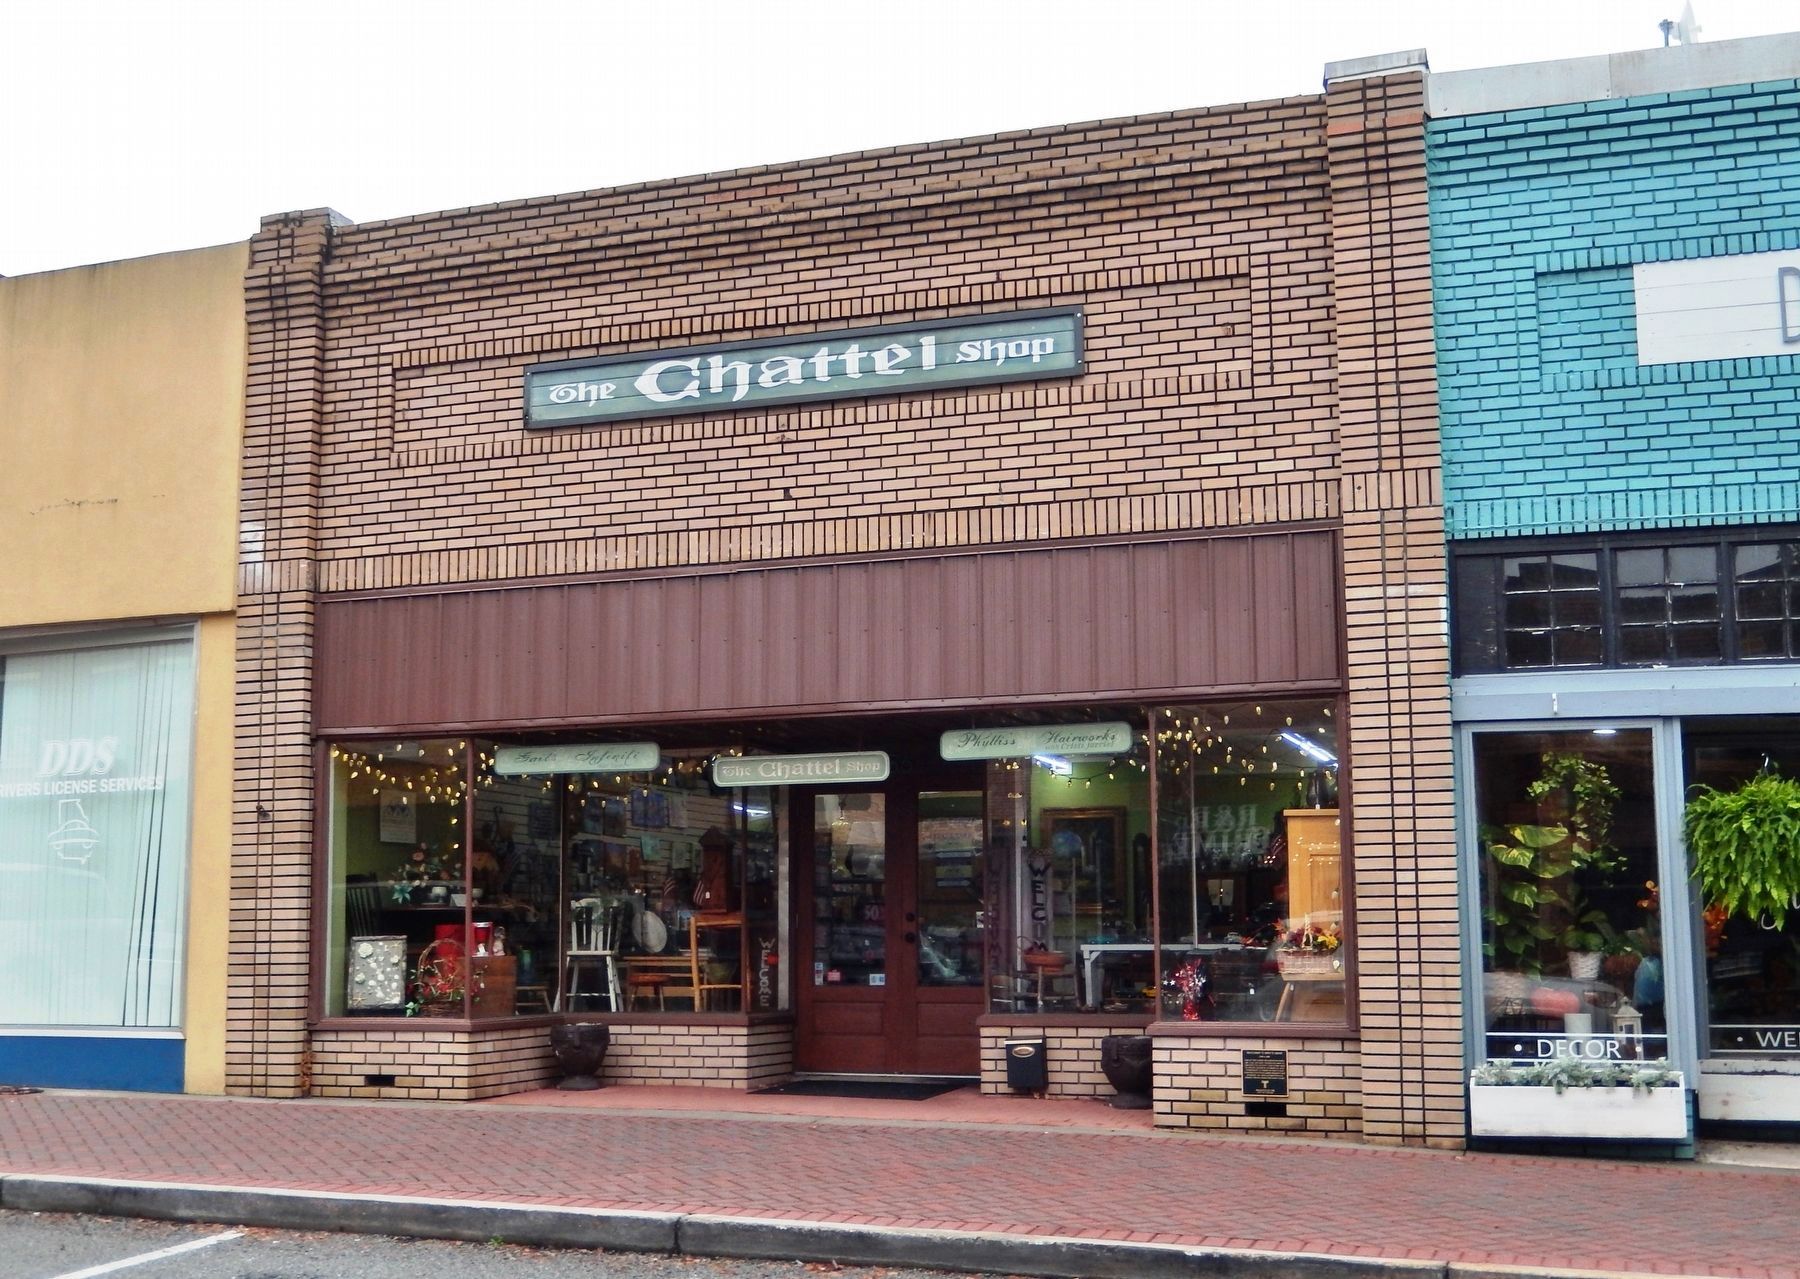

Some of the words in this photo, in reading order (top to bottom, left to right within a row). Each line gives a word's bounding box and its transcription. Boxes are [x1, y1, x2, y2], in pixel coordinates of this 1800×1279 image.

[549, 382, 617, 407] The
[633, 335, 936, 402] Chattel
[955, 337, 1055, 366] Shop
[37, 737, 116, 776] DDS
[722, 766, 751, 778] The
[758, 758, 840, 779] Chattel
[845, 760, 881, 773] Shop
[44, 779, 97, 795] LICENSE
[100, 775, 164, 793] SERVICES
[1537, 1039, 1622, 1059] DECOR
[1755, 1031, 1800, 1048] WE
